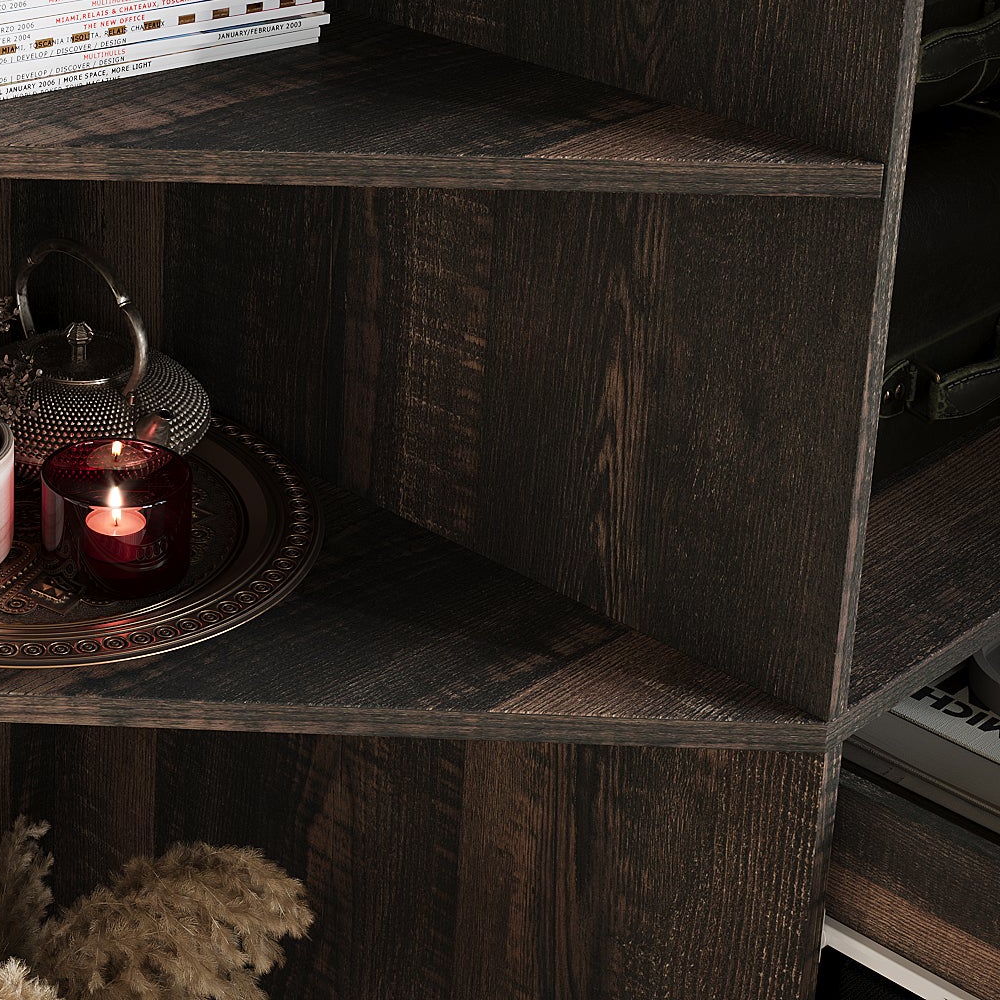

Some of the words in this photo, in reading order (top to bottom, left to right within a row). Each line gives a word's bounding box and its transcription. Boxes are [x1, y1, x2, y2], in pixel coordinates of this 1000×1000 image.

[10, 1, 27, 9] 2006
[17, 23, 35, 31] 2006
[83, 22, 97, 30] THE
[100, 19, 117, 27] NEW
[119, 14, 145, 24] OFFICE
[14, 34, 31, 42] 2004
[217, 25, 284, 40] JANUARY/FEBRUARY
[286, 21, 302, 29] 2003
[17, 51, 49, 62] DEVELOP
[57, 44, 92, 55] DISCOVER
[101, 38, 127, 48] DESIGN
[84, 49, 126, 60] MULTIHULLS
[17, 70, 47, 81] DEVELOP
[56, 63, 90, 73] DISCOVER
[99, 56, 125, 65] DESIGN
[5, 83, 36, 95] JANUARY
[39, 79, 56, 88] 2006
[64, 73, 83, 82] MORE
[85, 70, 108, 80] SPACE,
[111, 66, 130, 74] MORE
[132, 61, 152, 71] LIGHT
